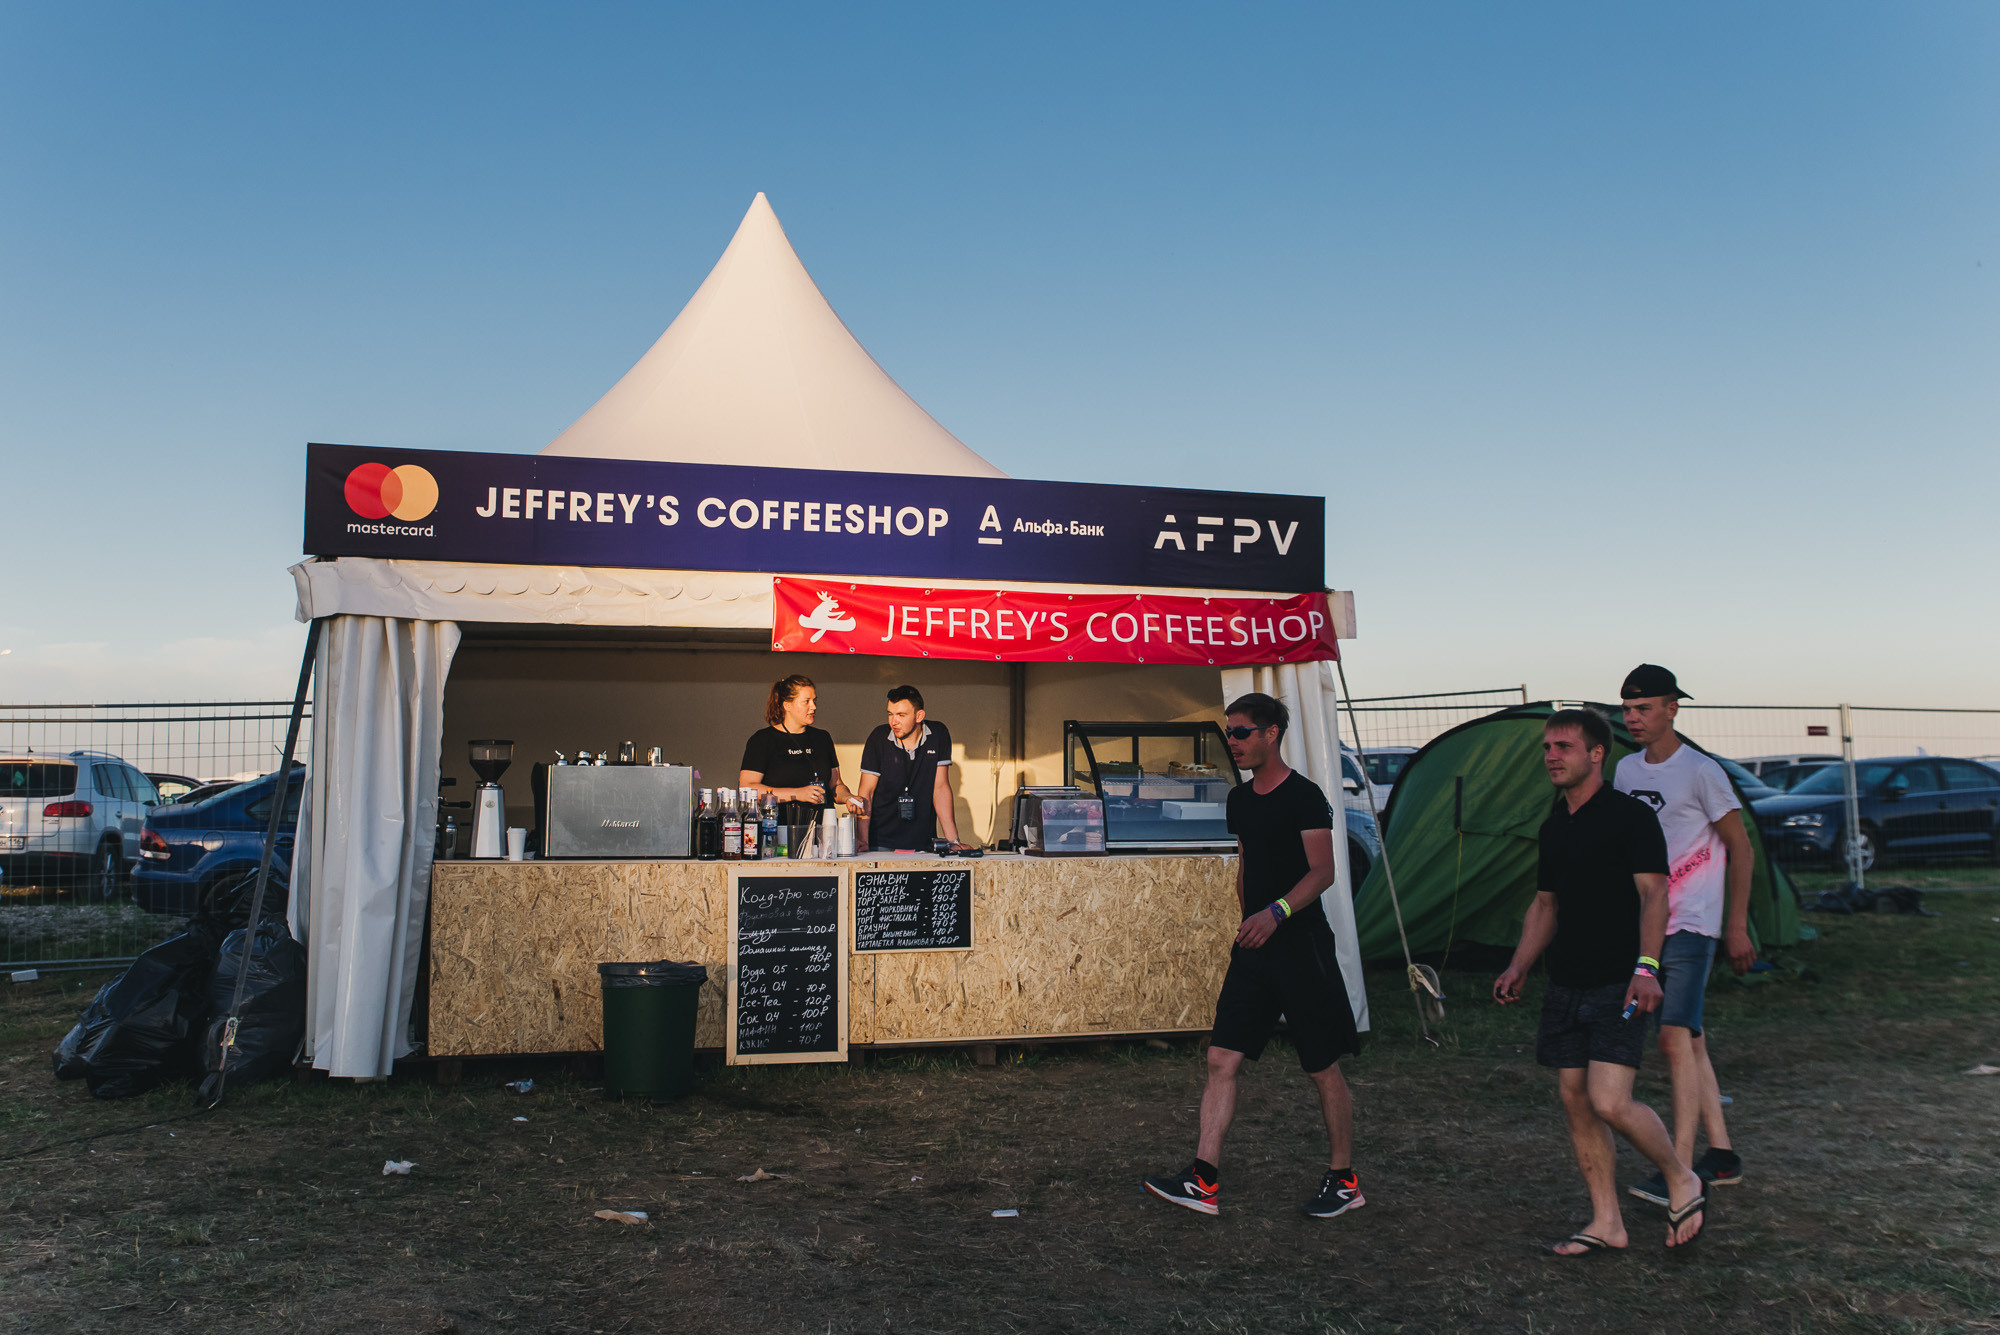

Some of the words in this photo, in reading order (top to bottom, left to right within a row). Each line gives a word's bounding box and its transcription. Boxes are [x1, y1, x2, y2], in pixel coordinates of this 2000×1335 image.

[476, 487, 680, 526] JEFFREY'S
[697, 497, 949, 536] COFFEESHOP
[347, 522, 435, 537] mastercard
[1154, 514, 1299, 555] AFPV
[881, 605, 1069, 642] JEFFREY'S
[1086, 610, 1324, 646] COFFEESHOP
[858, 873, 909, 887] СЭНДВИЧ
[857, 906, 875, 917] ТОРТ
[857, 915, 874, 926] ТОРТ
[858, 923, 890, 934] БРАУНИ
[858, 932, 878, 941] ПИРОГ
[741, 965, 766, 982] Вода
[772, 964, 788, 974] 0,5
[741, 981, 767, 995] Чай
[739, 995, 781, 1009] Ice-Tea
[739, 1012, 759, 1025] Сок
[739, 1025, 777, 1039] МАФФИН
[739, 1039, 770, 1050] КУКИС
